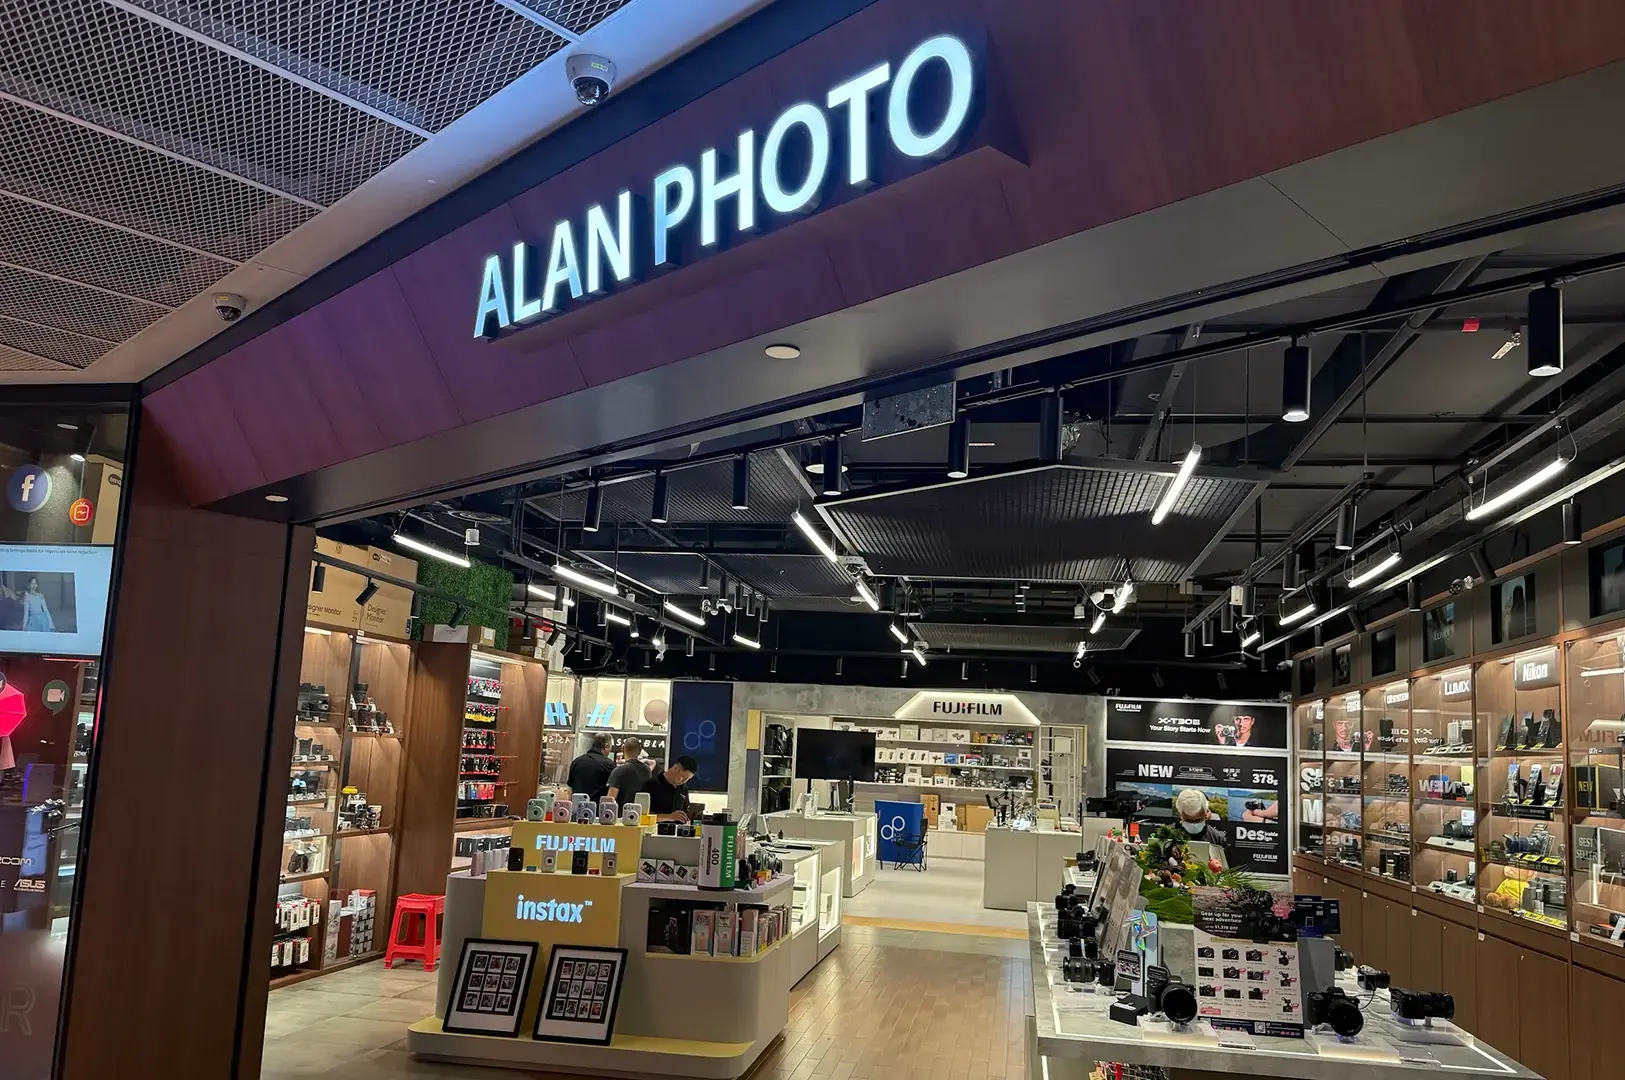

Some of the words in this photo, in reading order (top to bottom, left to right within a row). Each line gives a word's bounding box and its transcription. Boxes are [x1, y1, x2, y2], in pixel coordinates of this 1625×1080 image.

[473, 189, 632, 340] ALAN
[653, 34, 974, 267] PHOTO
[1522, 663, 1548, 682] Nikon
[1444, 680, 1470, 696] LUMIX
[933, 701, 1003, 716] FUJIFILM
[1138, 764, 1173, 778] NEW
[1578, 780, 1593, 792] NEW
[536, 834, 616, 853] FUJIFILM
[1578, 837, 1594, 848] BEST
[711, 847, 720, 866] 400
[725, 835, 734, 878] FUJIFILM
[14, 879, 46, 889] ASUS
